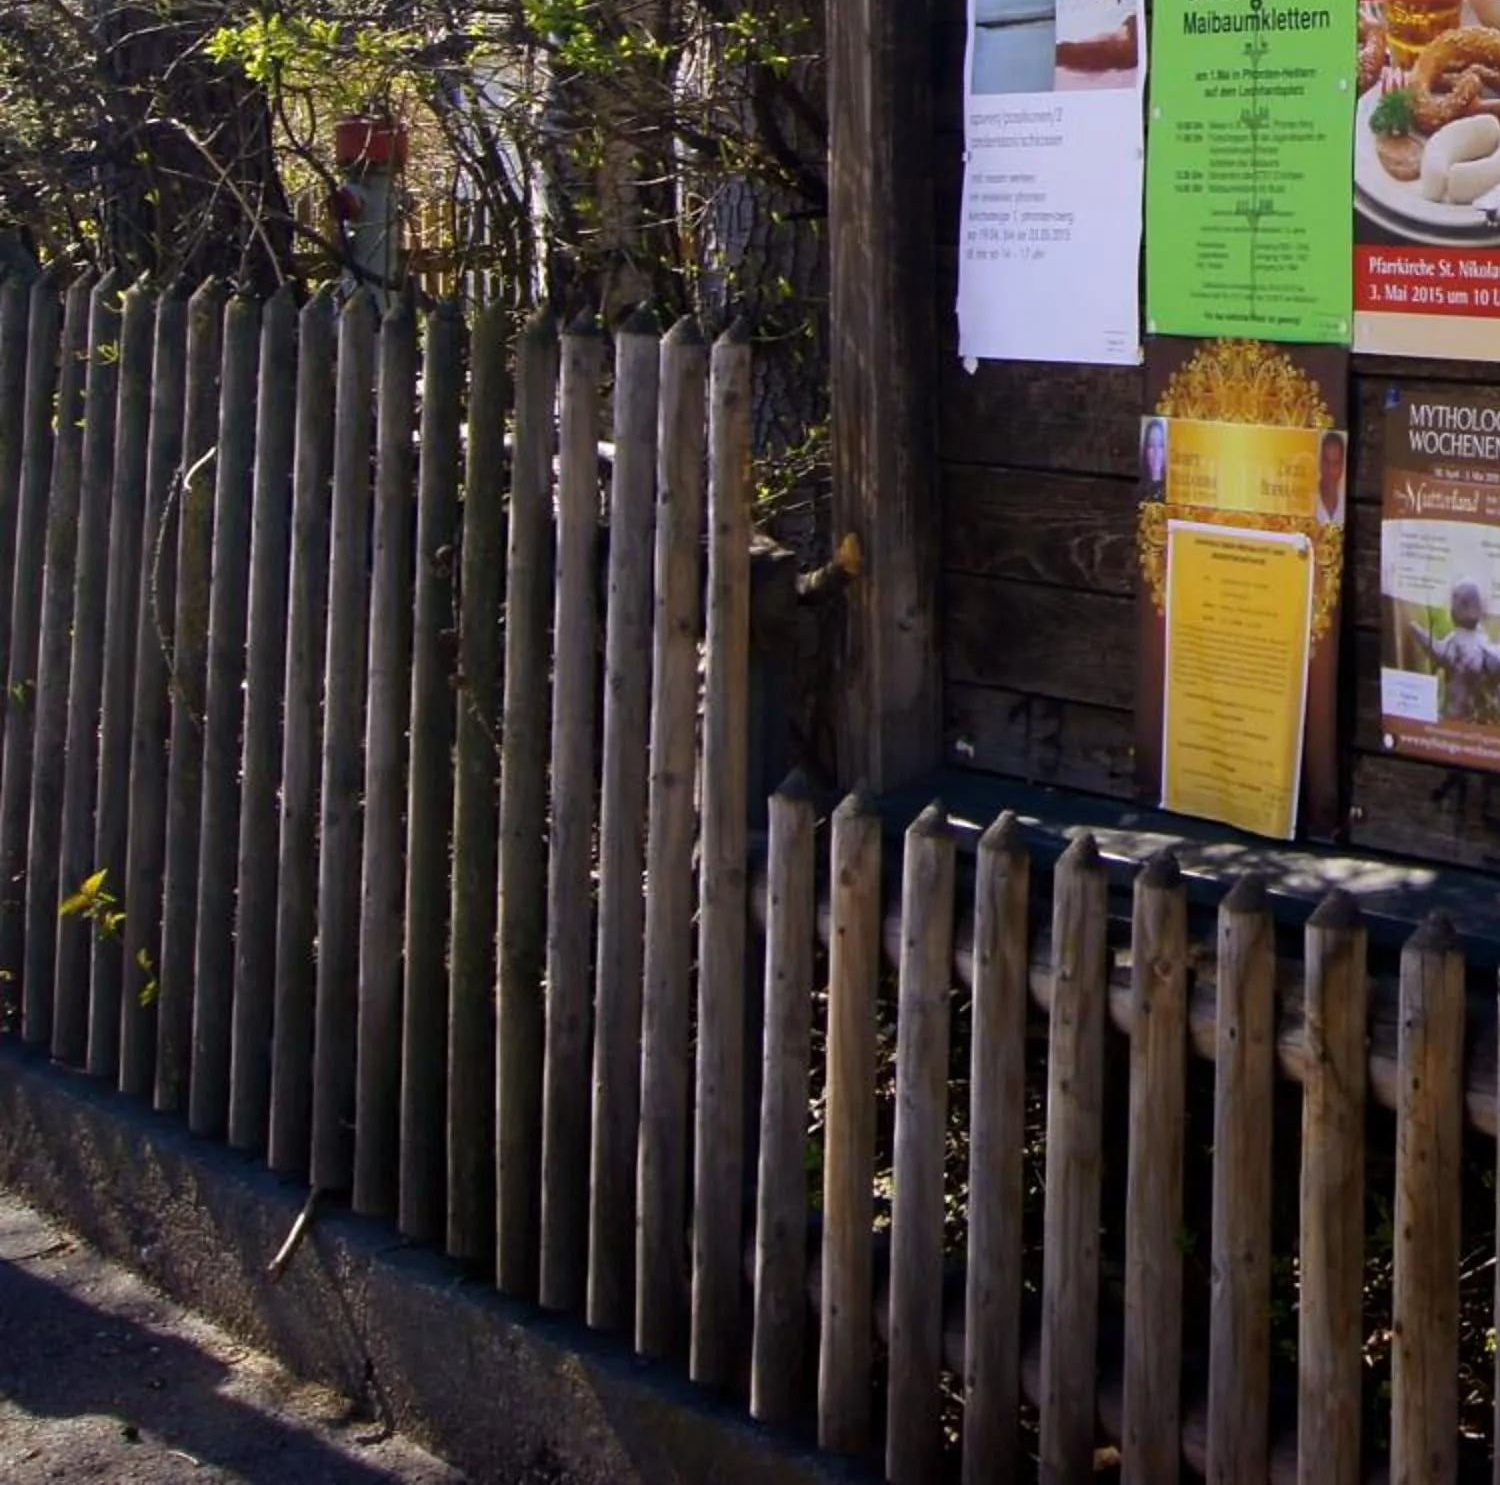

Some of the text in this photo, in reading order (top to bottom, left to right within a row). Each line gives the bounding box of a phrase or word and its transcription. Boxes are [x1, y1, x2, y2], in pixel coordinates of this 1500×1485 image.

[1183, 6, 1331, 35] Maibaumklettern
[1369, 256, 1436, 278] Pfarrkirche
[1438, 259, 1456, 279] St.
[1385, 284, 1408, 303] Mai
[1411, 285, 1445, 305] 2015
[1446, 290, 1469, 307] um
[1473, 287, 1489, 307] 10
